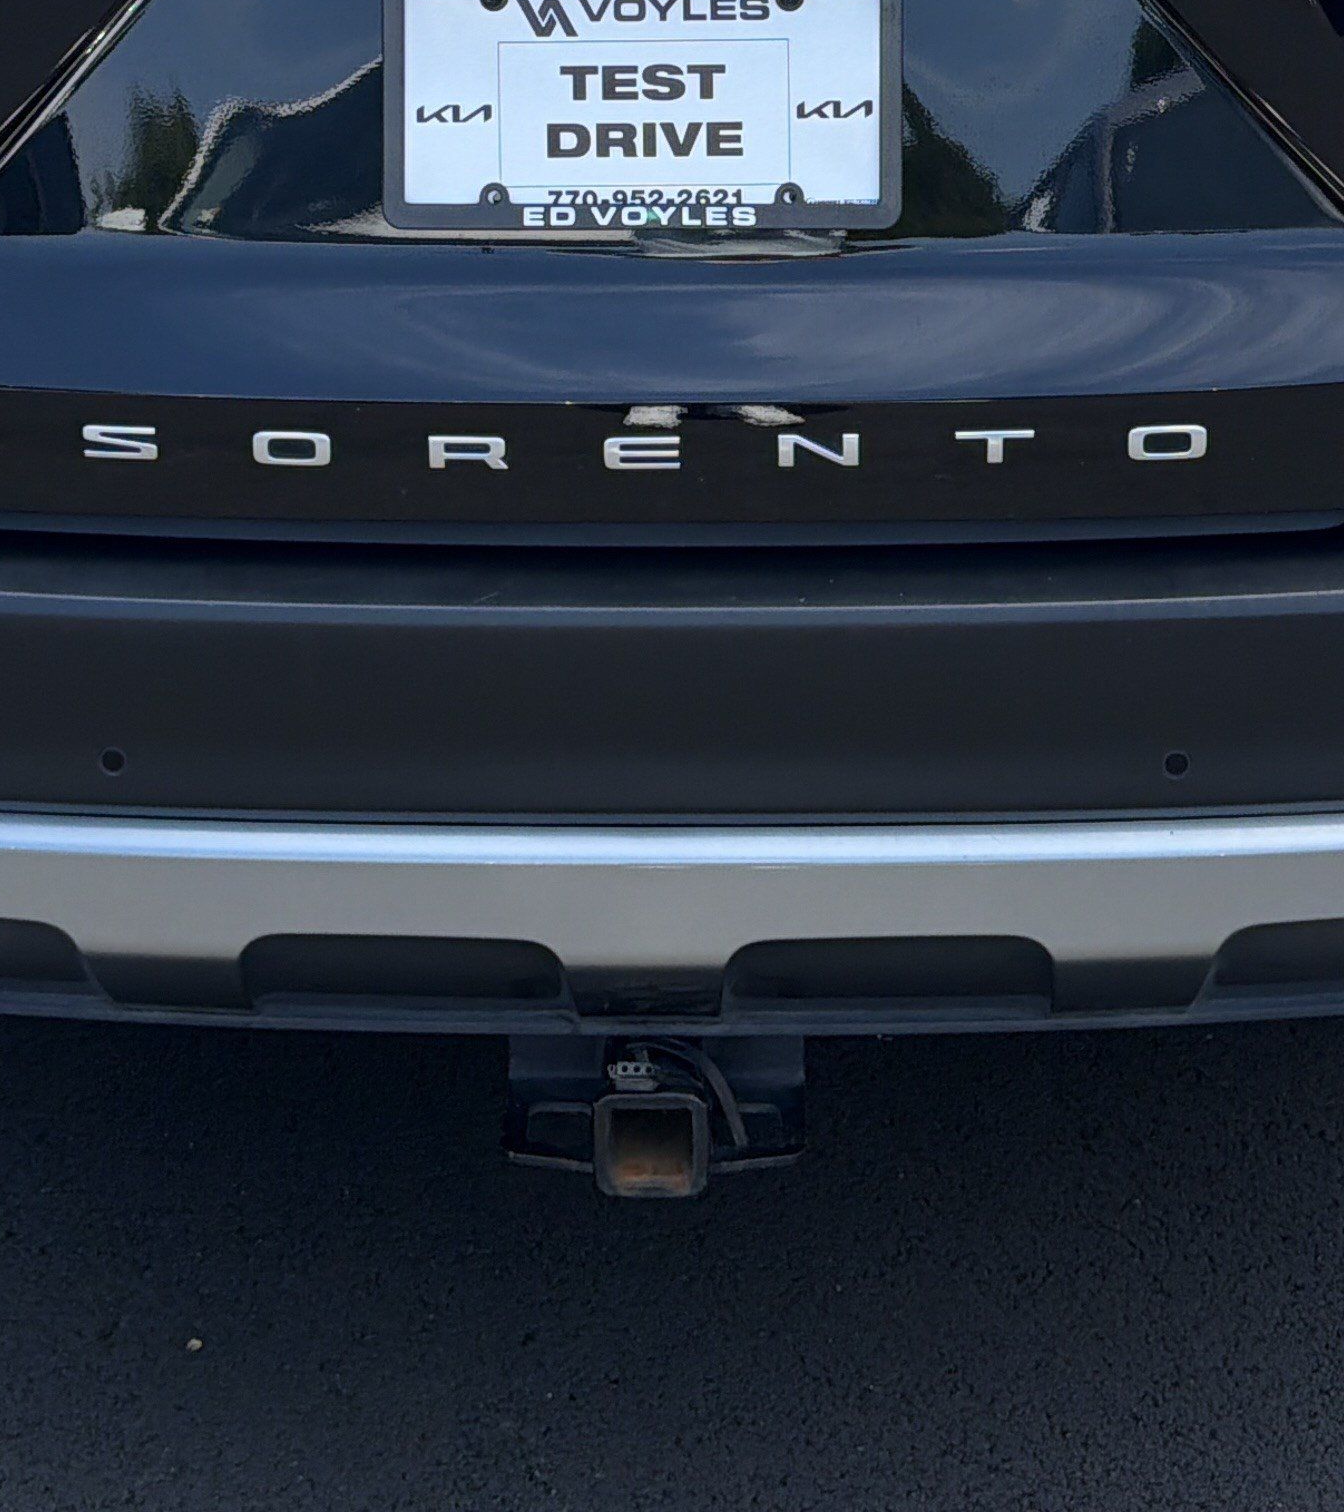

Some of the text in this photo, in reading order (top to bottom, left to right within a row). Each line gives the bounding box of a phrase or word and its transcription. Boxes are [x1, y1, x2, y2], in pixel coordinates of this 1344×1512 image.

[559, 63, 726, 101] TEST
[416, 103, 493, 124] KIA
[796, 99, 874, 120] KIA
[545, 120, 744, 159] DRIVE
[547, 188, 743, 205] 770-952-2621
[522, 206, 758, 227] ED VOYLES
[81, 423, 1208, 470] SORENTO
